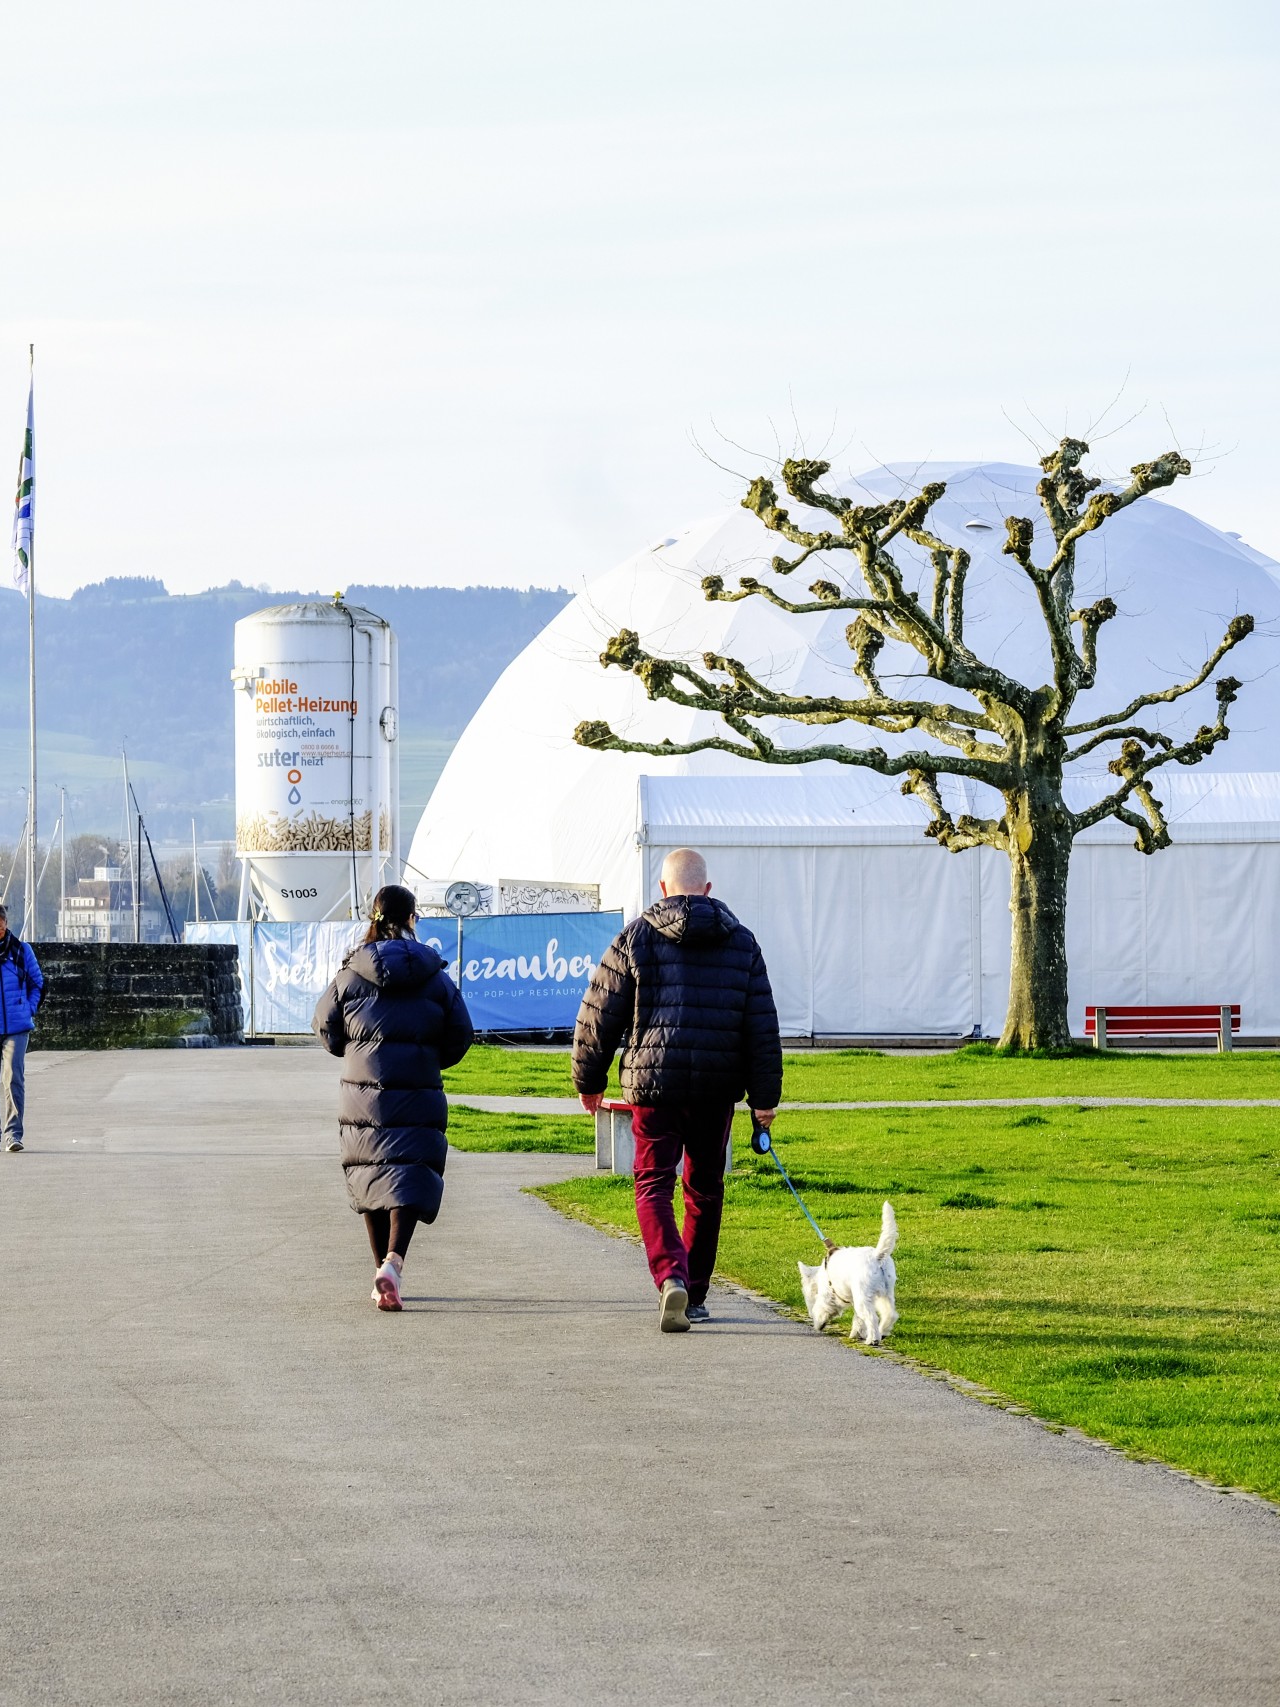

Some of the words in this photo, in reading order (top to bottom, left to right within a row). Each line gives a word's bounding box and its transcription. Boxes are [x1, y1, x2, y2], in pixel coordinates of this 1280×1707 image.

[256, 679, 298, 694] Mobile
[256, 697, 358, 715] Pellet-Heizung
[256, 716, 315, 726] wirtschaftlich,
[256, 728, 301, 739] ökologisch,
[301, 728, 336, 737] einfach
[257, 748, 299, 767] suter
[301, 757, 324, 766] heizt
[281, 887, 318, 898] S1003
[425, 937, 597, 983] eezauber
[484, 989, 524, 998] POP-UP
[529, 987, 587, 997] RESTAURA
